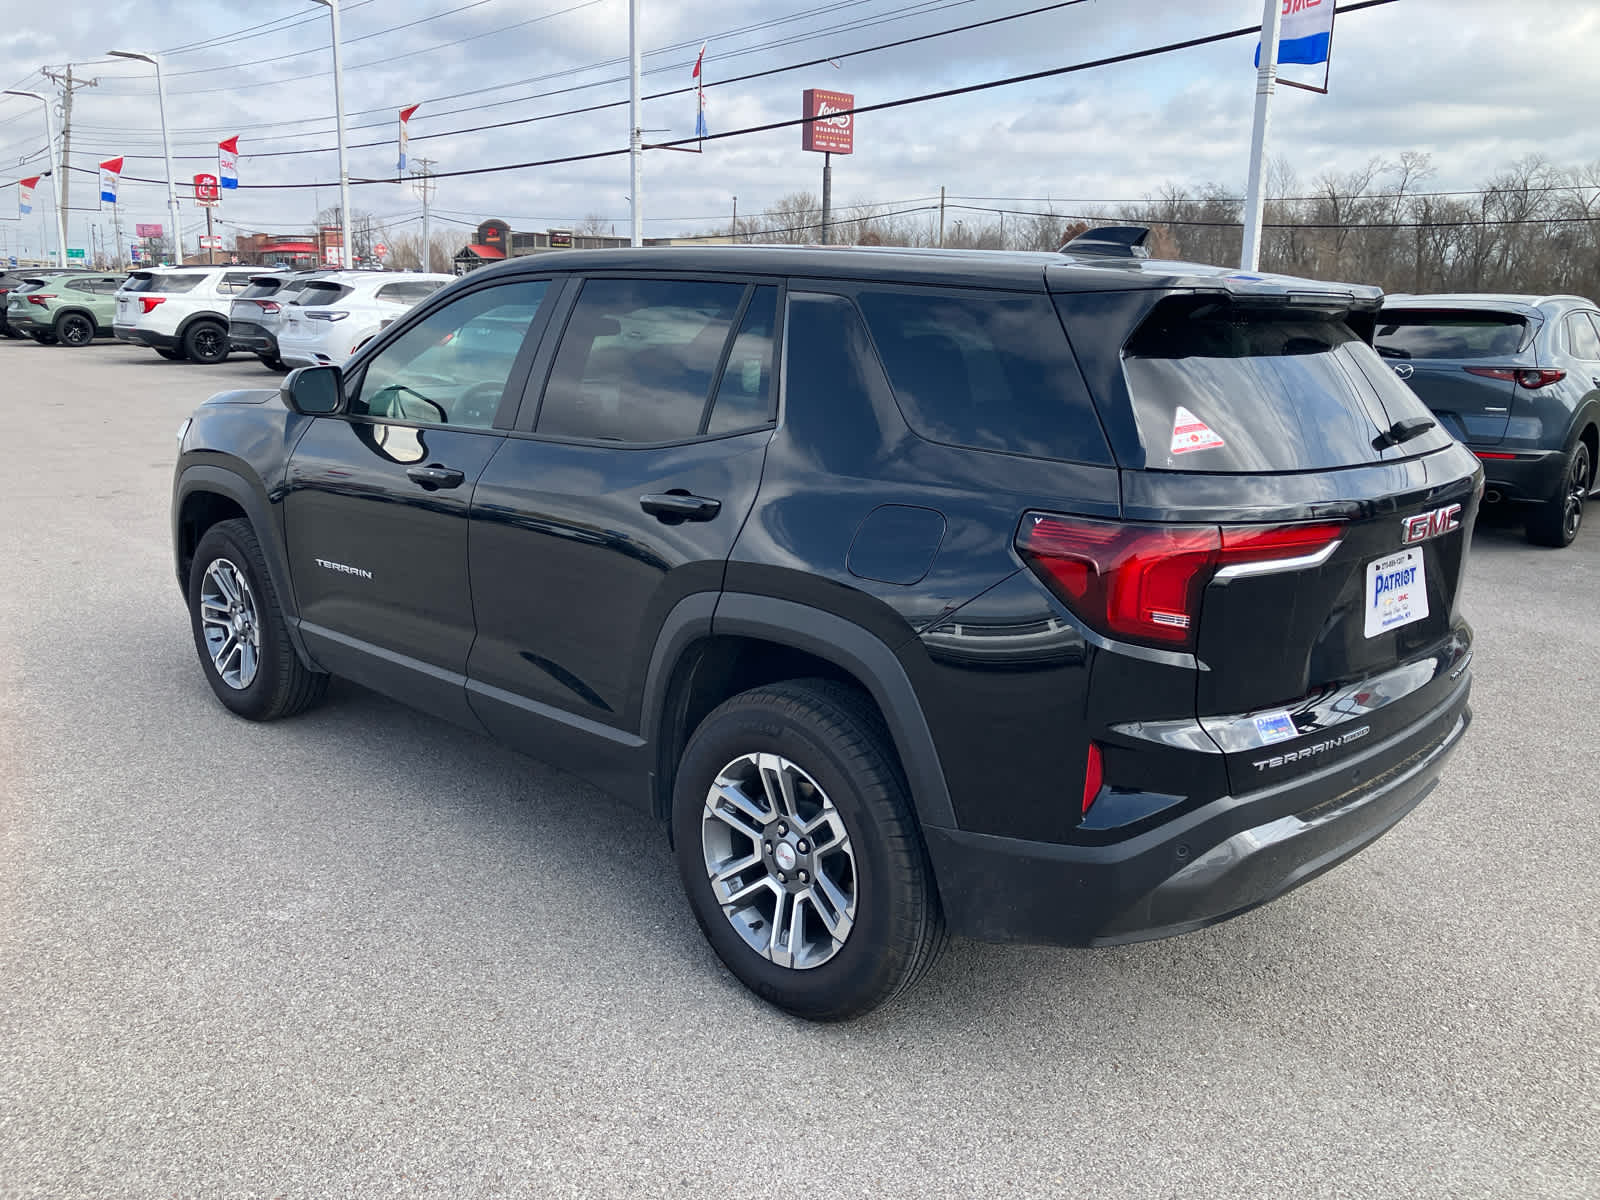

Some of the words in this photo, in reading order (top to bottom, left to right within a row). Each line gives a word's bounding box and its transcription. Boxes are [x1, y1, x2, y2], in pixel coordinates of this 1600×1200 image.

[1402, 503, 1461, 544] GMC
[315, 558, 373, 579] TERRAIN
[1374, 567, 1416, 608] PATRIOT
[1252, 734, 1342, 772] TERRAIN
